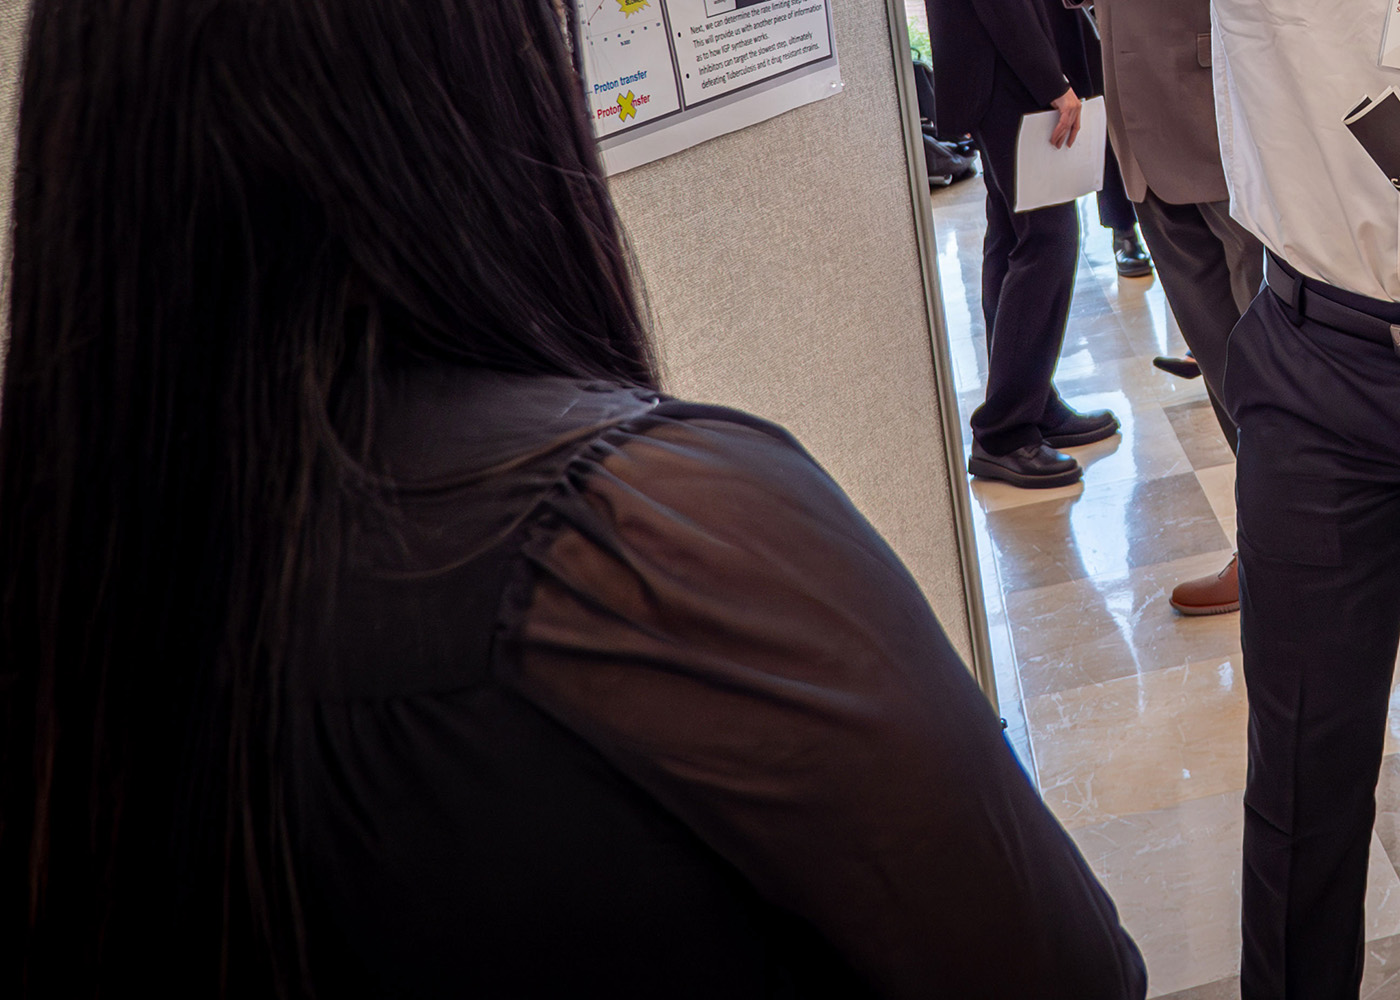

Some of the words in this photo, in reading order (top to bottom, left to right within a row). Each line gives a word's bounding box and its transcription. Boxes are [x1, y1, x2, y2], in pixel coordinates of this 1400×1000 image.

[693, 38, 704, 48] This
[715, 29, 734, 43] provide
[741, 23, 752, 33] with
[754, 18, 773, 29] another
[774, 14, 786, 25] piece
[794, 4, 822, 17] information
[724, 11, 750, 24] determine
[751, 8, 760, 16] the
[709, 49, 721, 57] how
[731, 38, 753, 51] synthase
[724, 59, 733, 67] can
[733, 53, 749, 64] target
[749, 50, 757, 58] the
[758, 43, 776, 56] slowest
[701, 75, 726, 89] defeating
[726, 64, 757, 80] Tuberculosis
[757, 59, 766, 70] and
[782, 48, 802, 60] resistant
[593, 80, 619, 94] Proton
[619, 70, 647, 86] transfer
